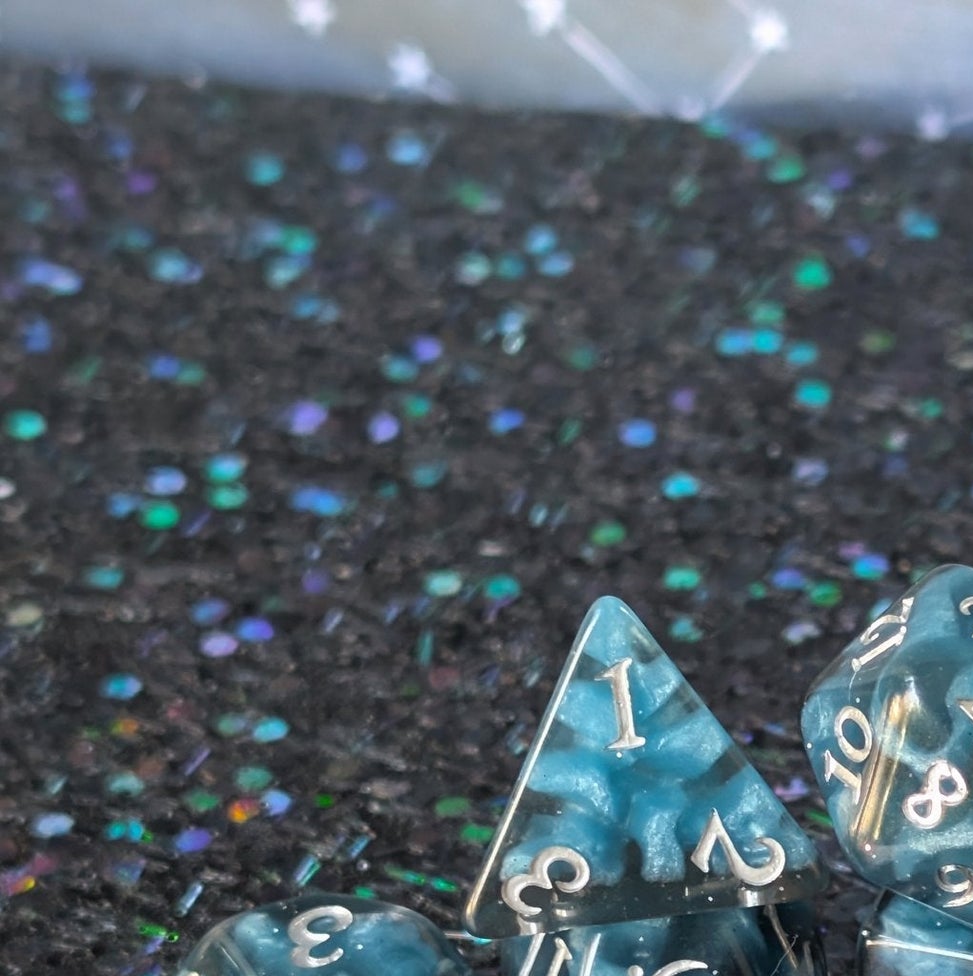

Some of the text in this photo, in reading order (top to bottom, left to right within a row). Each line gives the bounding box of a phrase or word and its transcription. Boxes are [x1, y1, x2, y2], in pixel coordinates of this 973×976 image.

[852, 596, 915, 672] 12
[594, 657, 647, 751] 1
[824, 705, 874, 804] 10
[902, 759, 969, 829] 8
[501, 846, 591, 916] 3
[690, 807, 786, 887] 2
[287, 904, 354, 968] 3
